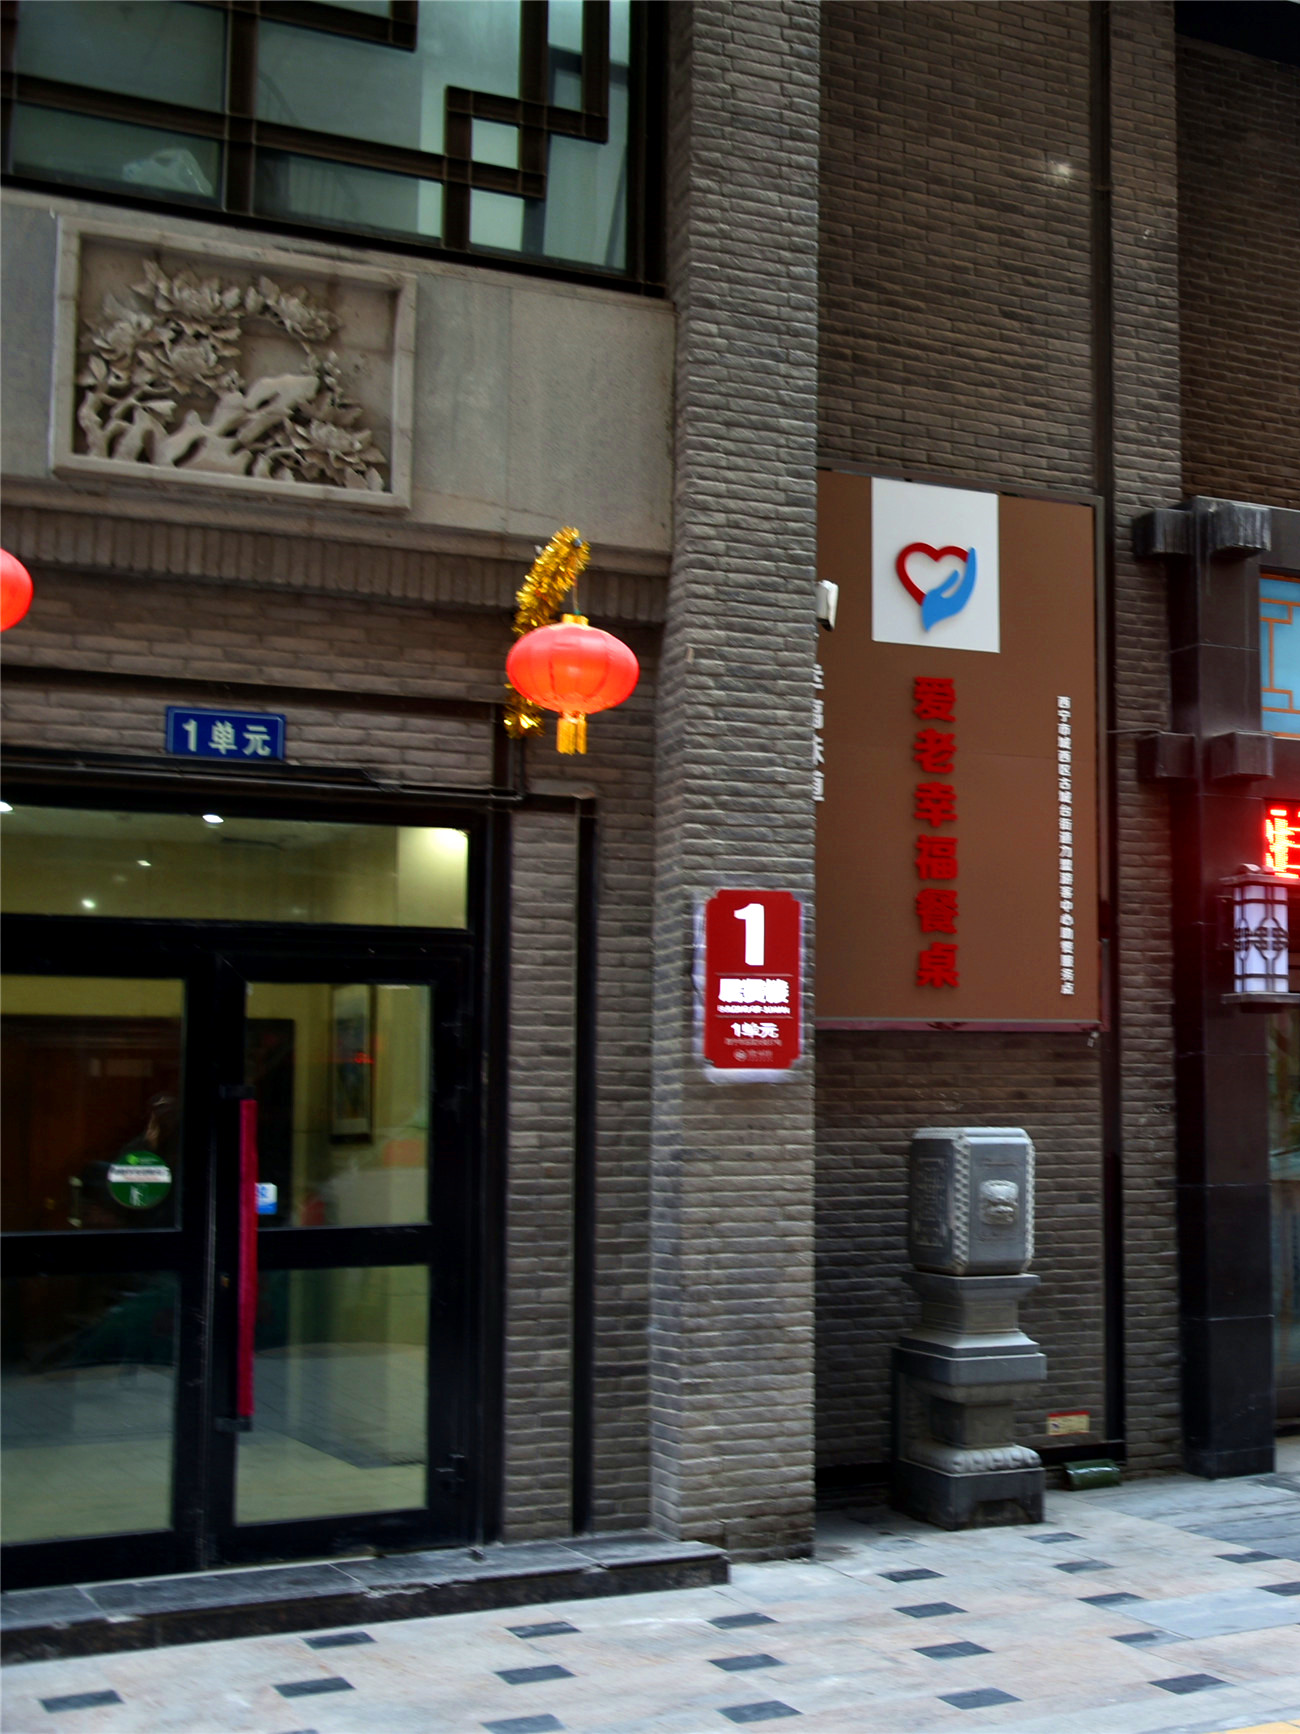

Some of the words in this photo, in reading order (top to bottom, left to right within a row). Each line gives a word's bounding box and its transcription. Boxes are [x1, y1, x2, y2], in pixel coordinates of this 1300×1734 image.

[182, 719, 271, 756] 1单元
[913, 676, 960, 988] 爱老幸福餐桌
[733, 903, 764, 966] 1
[730, 1022, 779, 1039] 1单元
